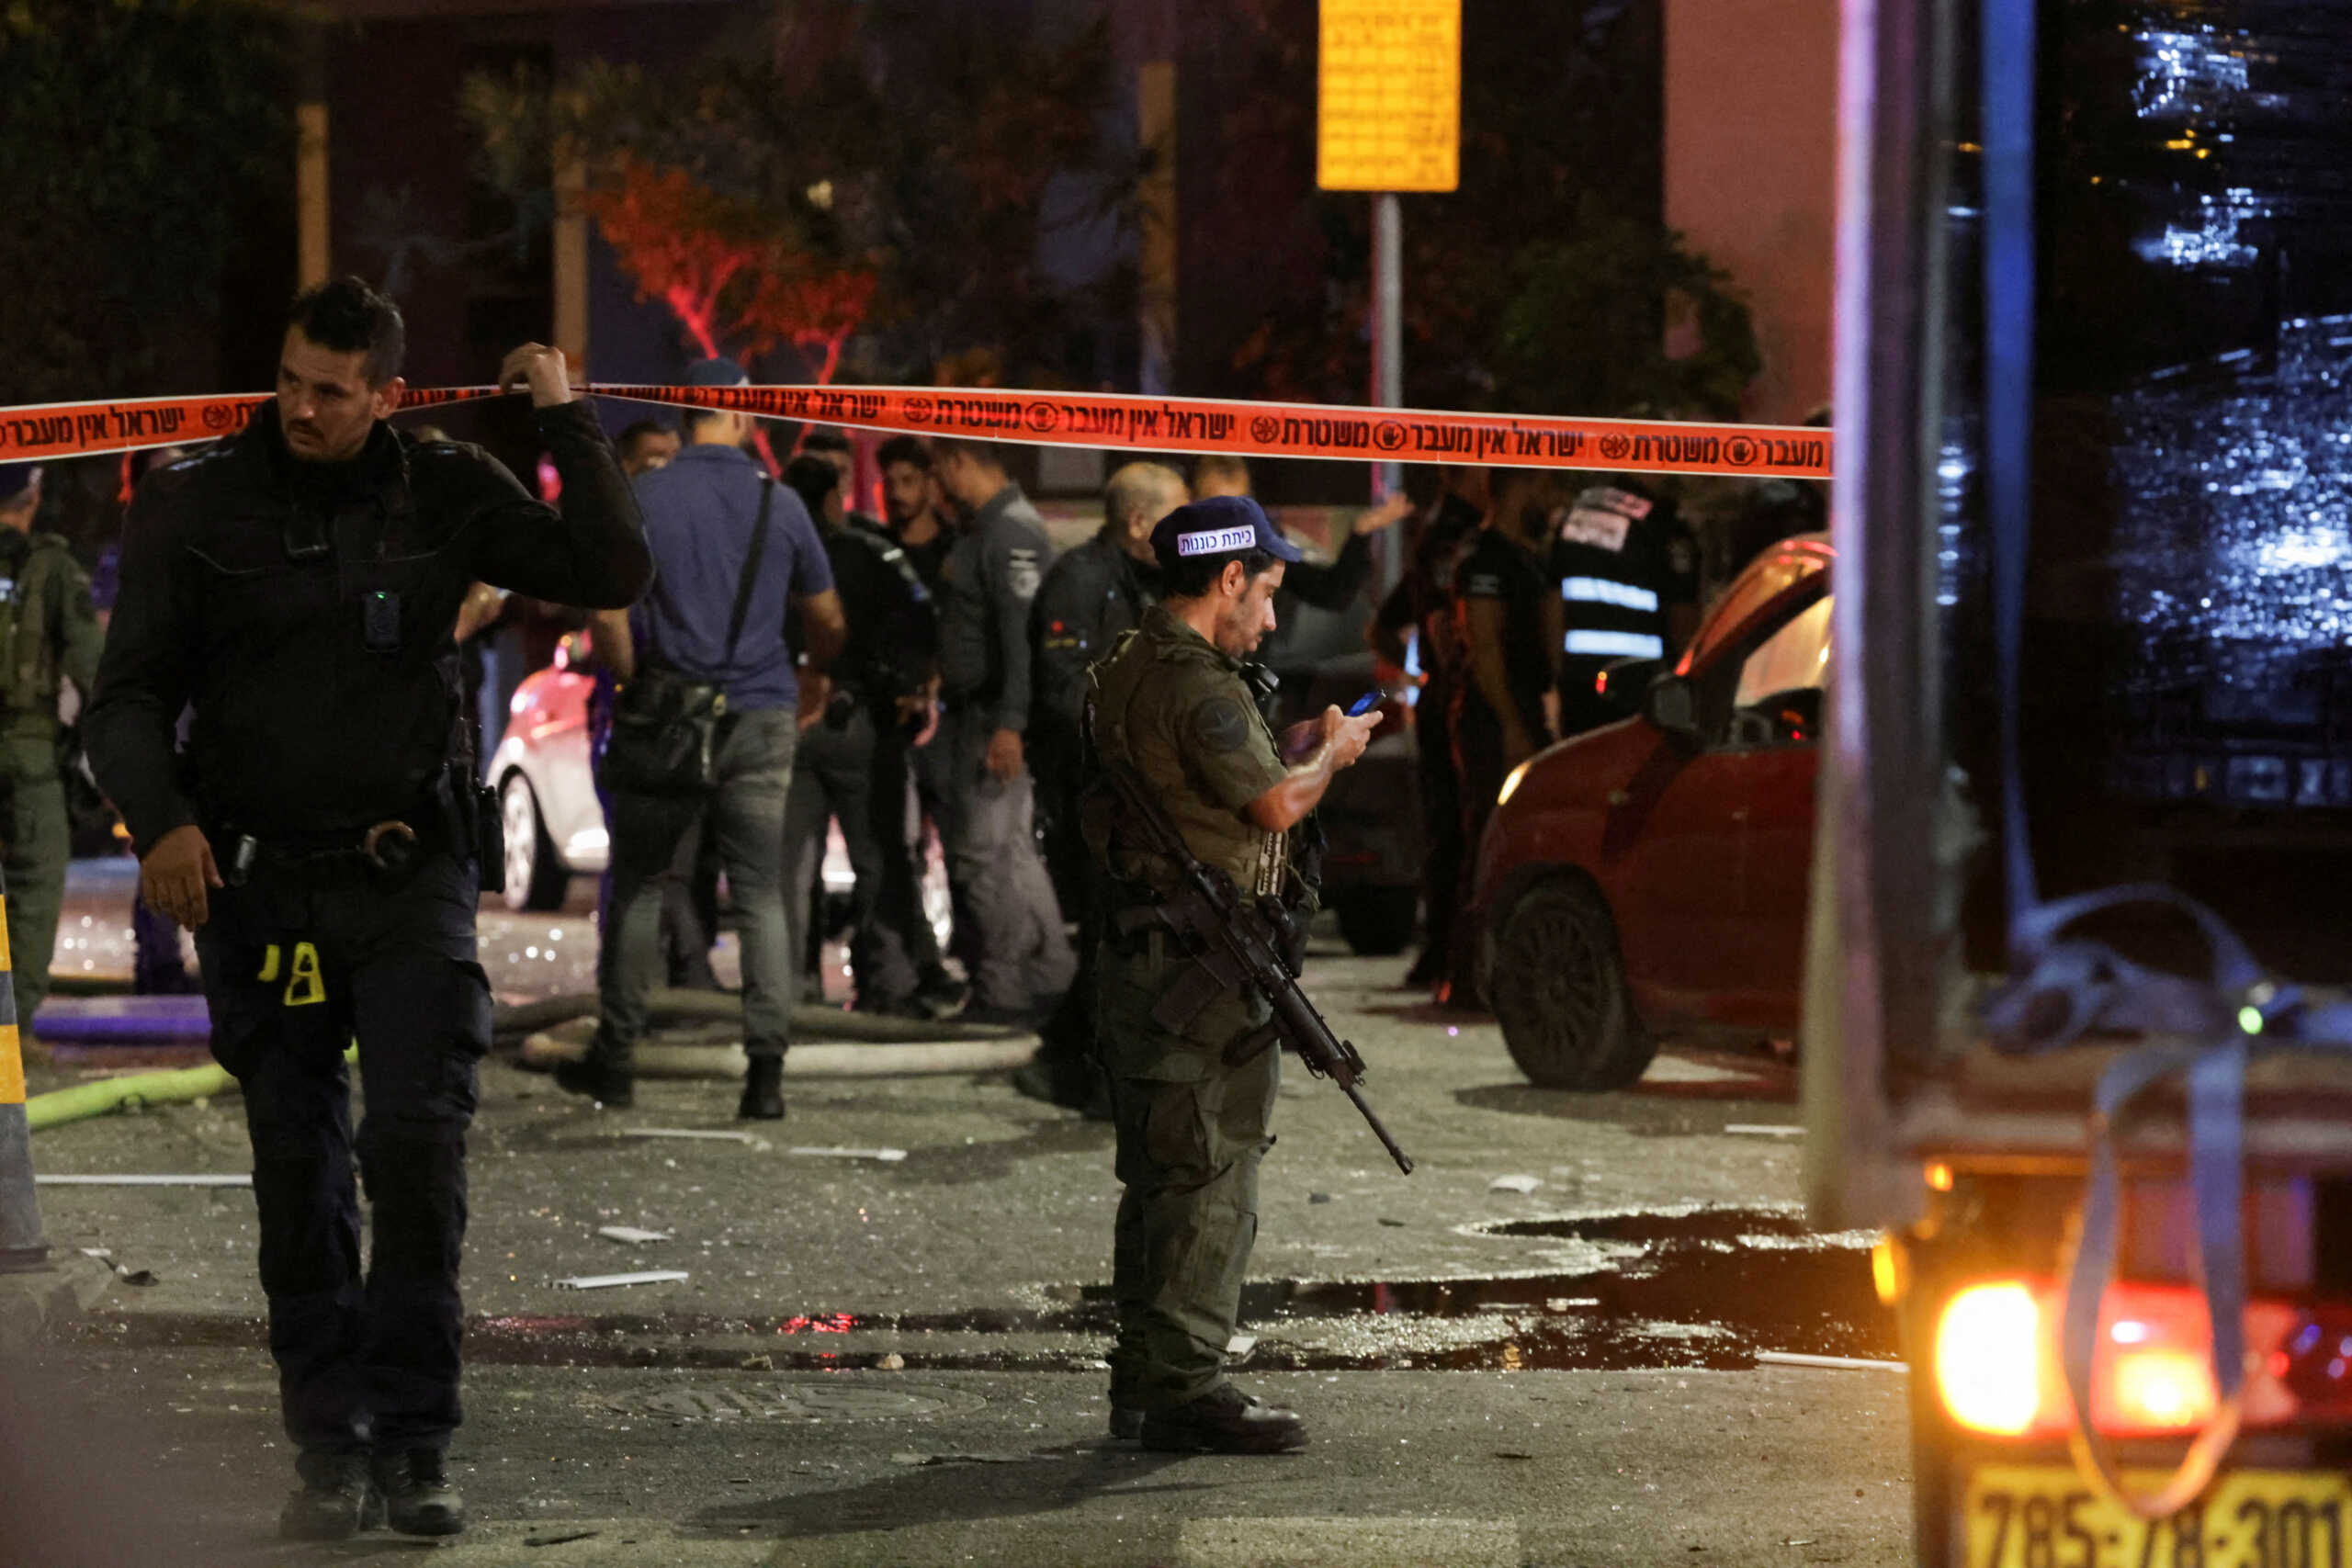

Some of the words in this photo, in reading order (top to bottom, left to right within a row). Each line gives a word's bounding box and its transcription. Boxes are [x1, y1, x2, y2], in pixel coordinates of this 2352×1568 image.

[780, 390, 809, 415] אין
[814, 389, 887, 419] ישראל
[934, 398, 1022, 430] משטרת
[7, 416, 74, 446] מעבר
[77, 412, 108, 447] אין
[109, 405, 186, 438] ישראל
[1062, 403, 1125, 434] מעבר
[1129, 408, 1158, 442] אין
[1162, 403, 1236, 441] ישראל
[1281, 417, 1371, 447] משטרת
[1409, 423, 1474, 453] מעבר
[1476, 426, 1508, 459] אין
[1511, 421, 1585, 457] ישראל
[1631, 434, 1720, 464] משטרת
[1759, 438, 1824, 468] מעבר
[1182, 535, 1217, 552] כוננות
[1221, 529, 1252, 547] כיתת
